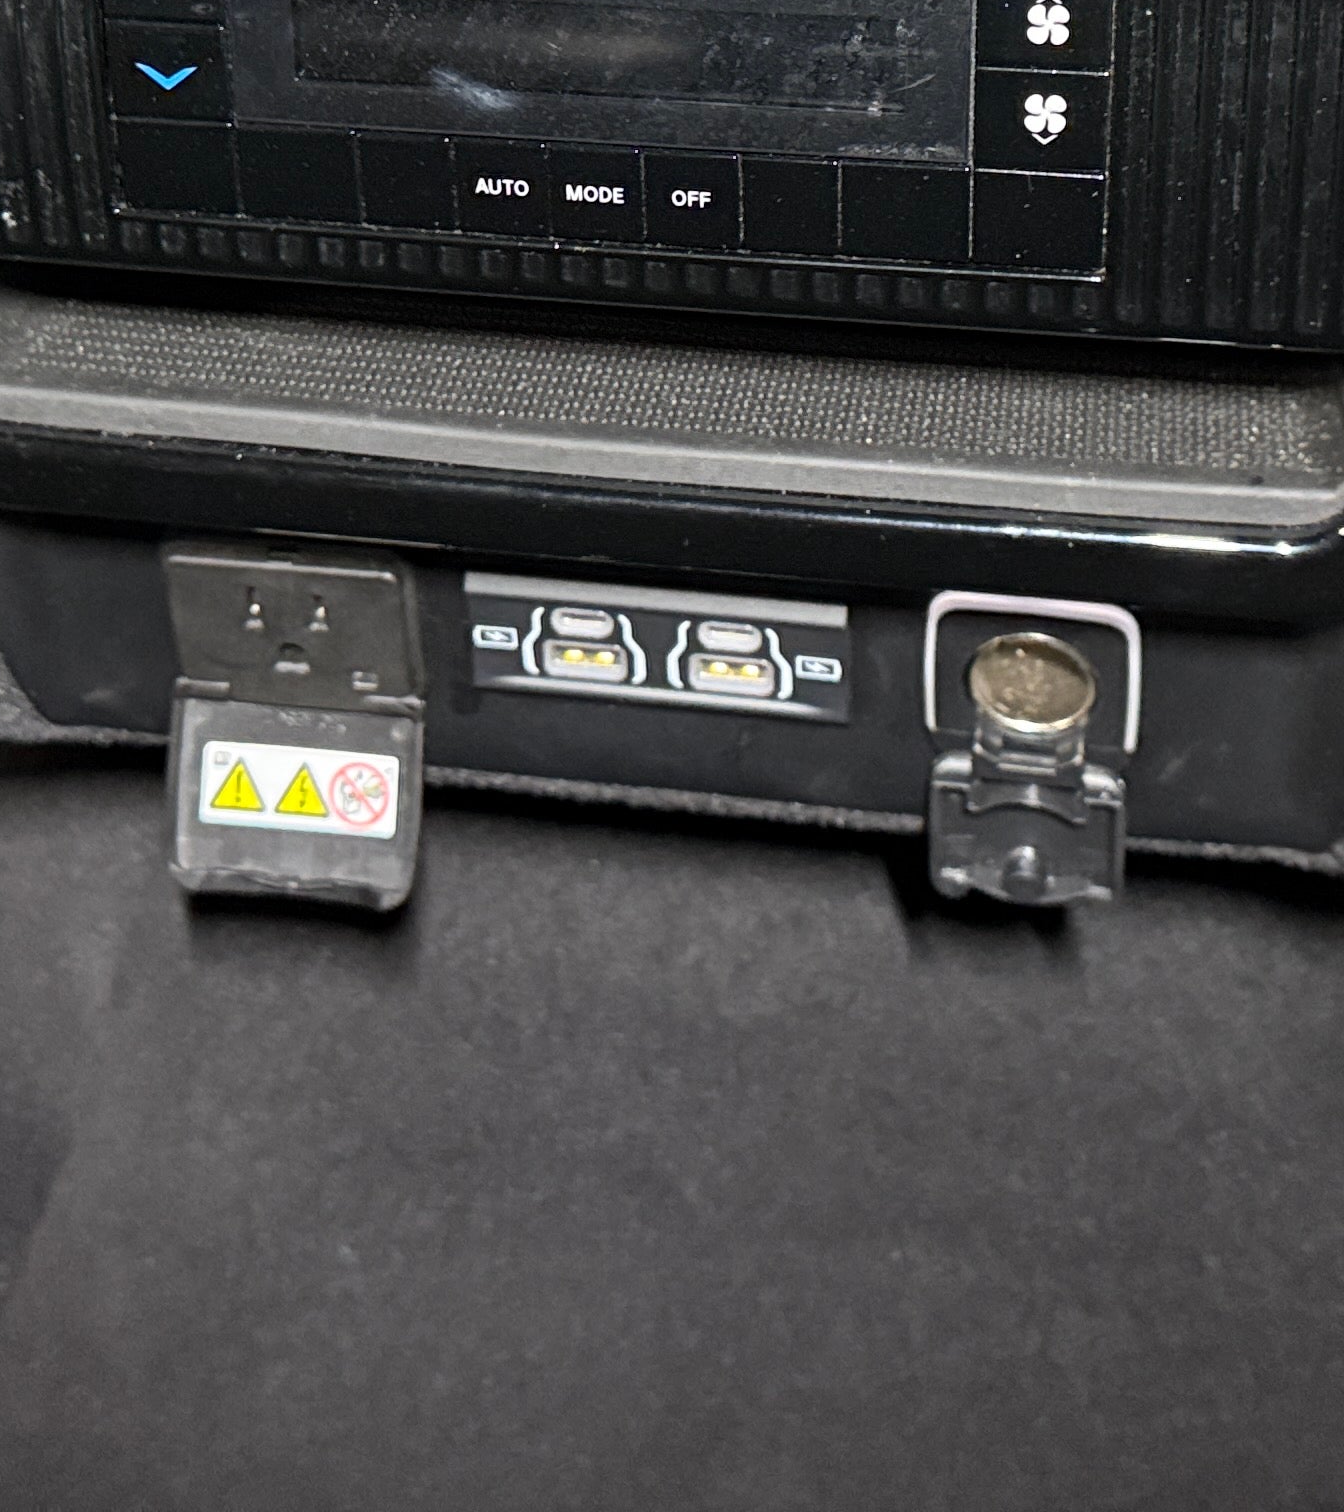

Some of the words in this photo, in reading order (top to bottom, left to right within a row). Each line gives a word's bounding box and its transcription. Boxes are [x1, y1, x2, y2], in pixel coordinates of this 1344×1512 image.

[474, 177, 530, 197] AUTO
[565, 183, 625, 205] MODE
[671, 189, 712, 209] OFF
